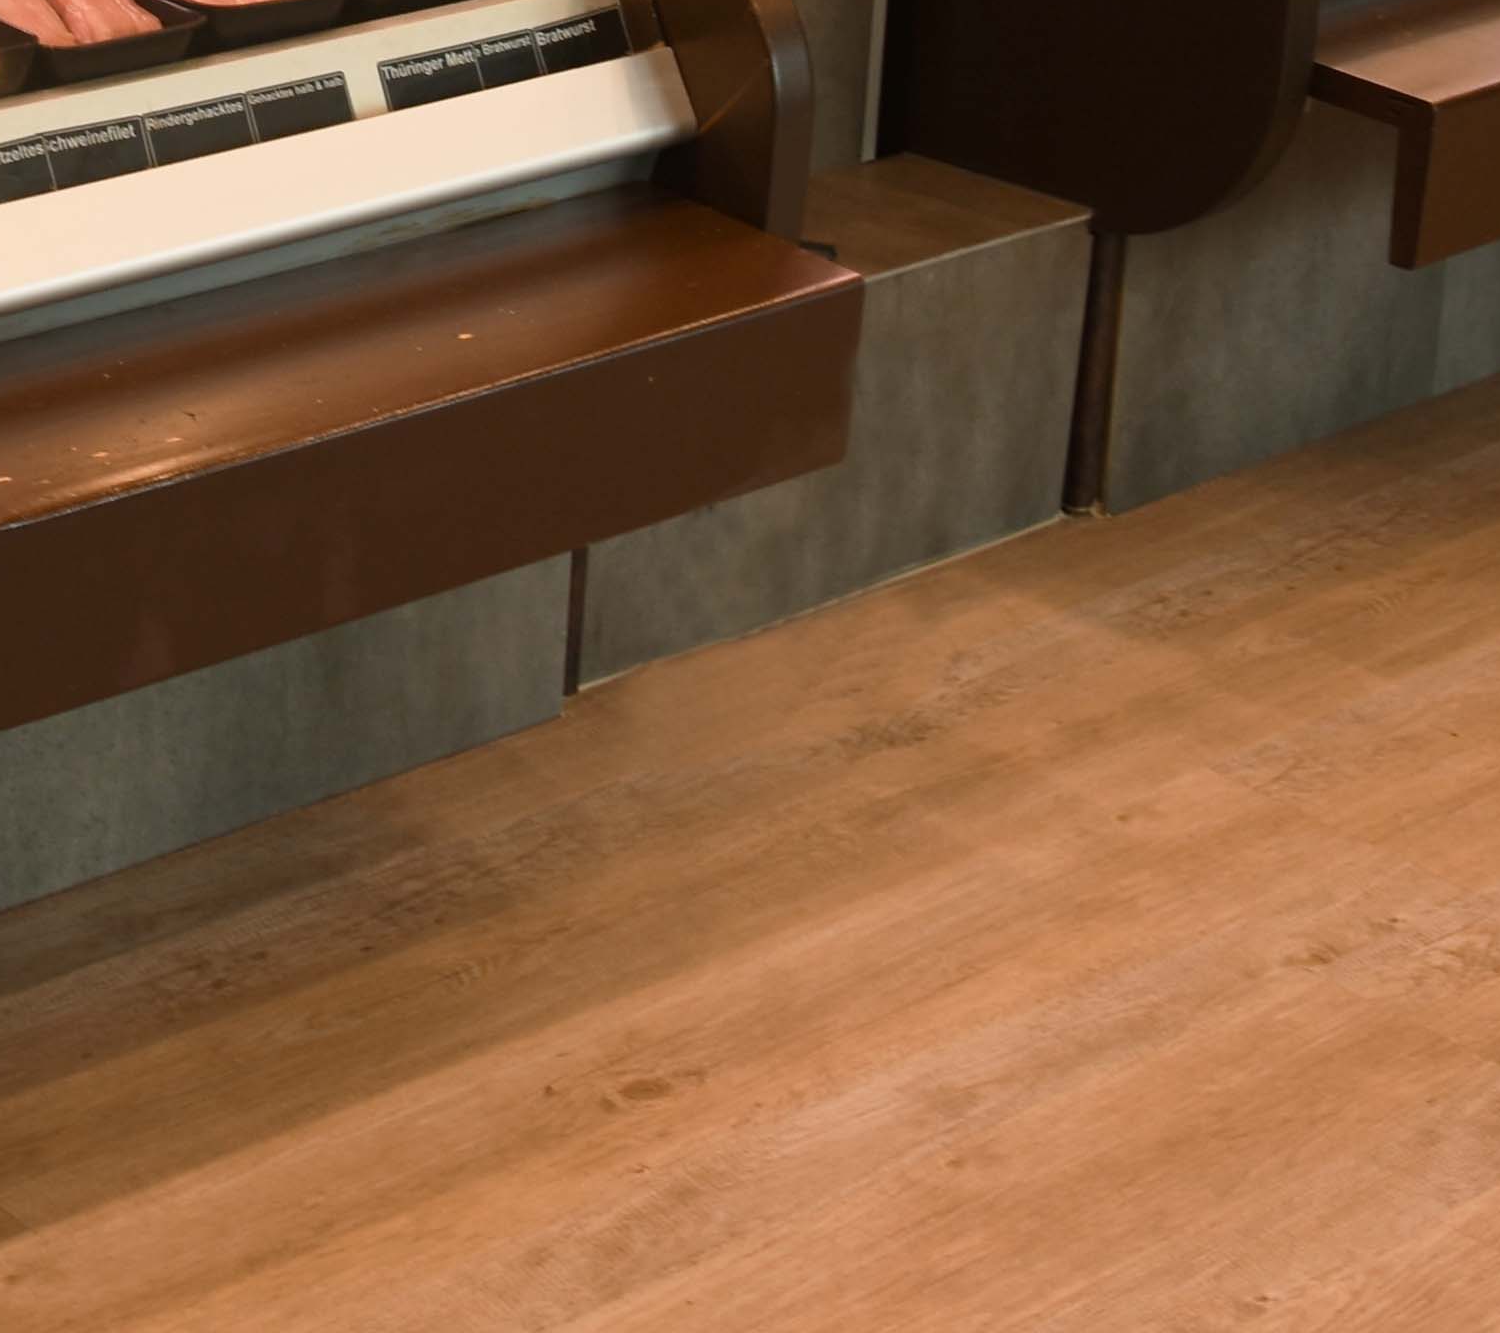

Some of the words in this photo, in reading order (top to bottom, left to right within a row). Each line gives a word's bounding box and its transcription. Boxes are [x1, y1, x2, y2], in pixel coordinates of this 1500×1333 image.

[483, 34, 532, 56] Bratwurst
[535, 19, 597, 46] Bratwurst
[382, 58, 444, 82] Thüringer
[145, 100, 243, 132] Rindergehacktes
